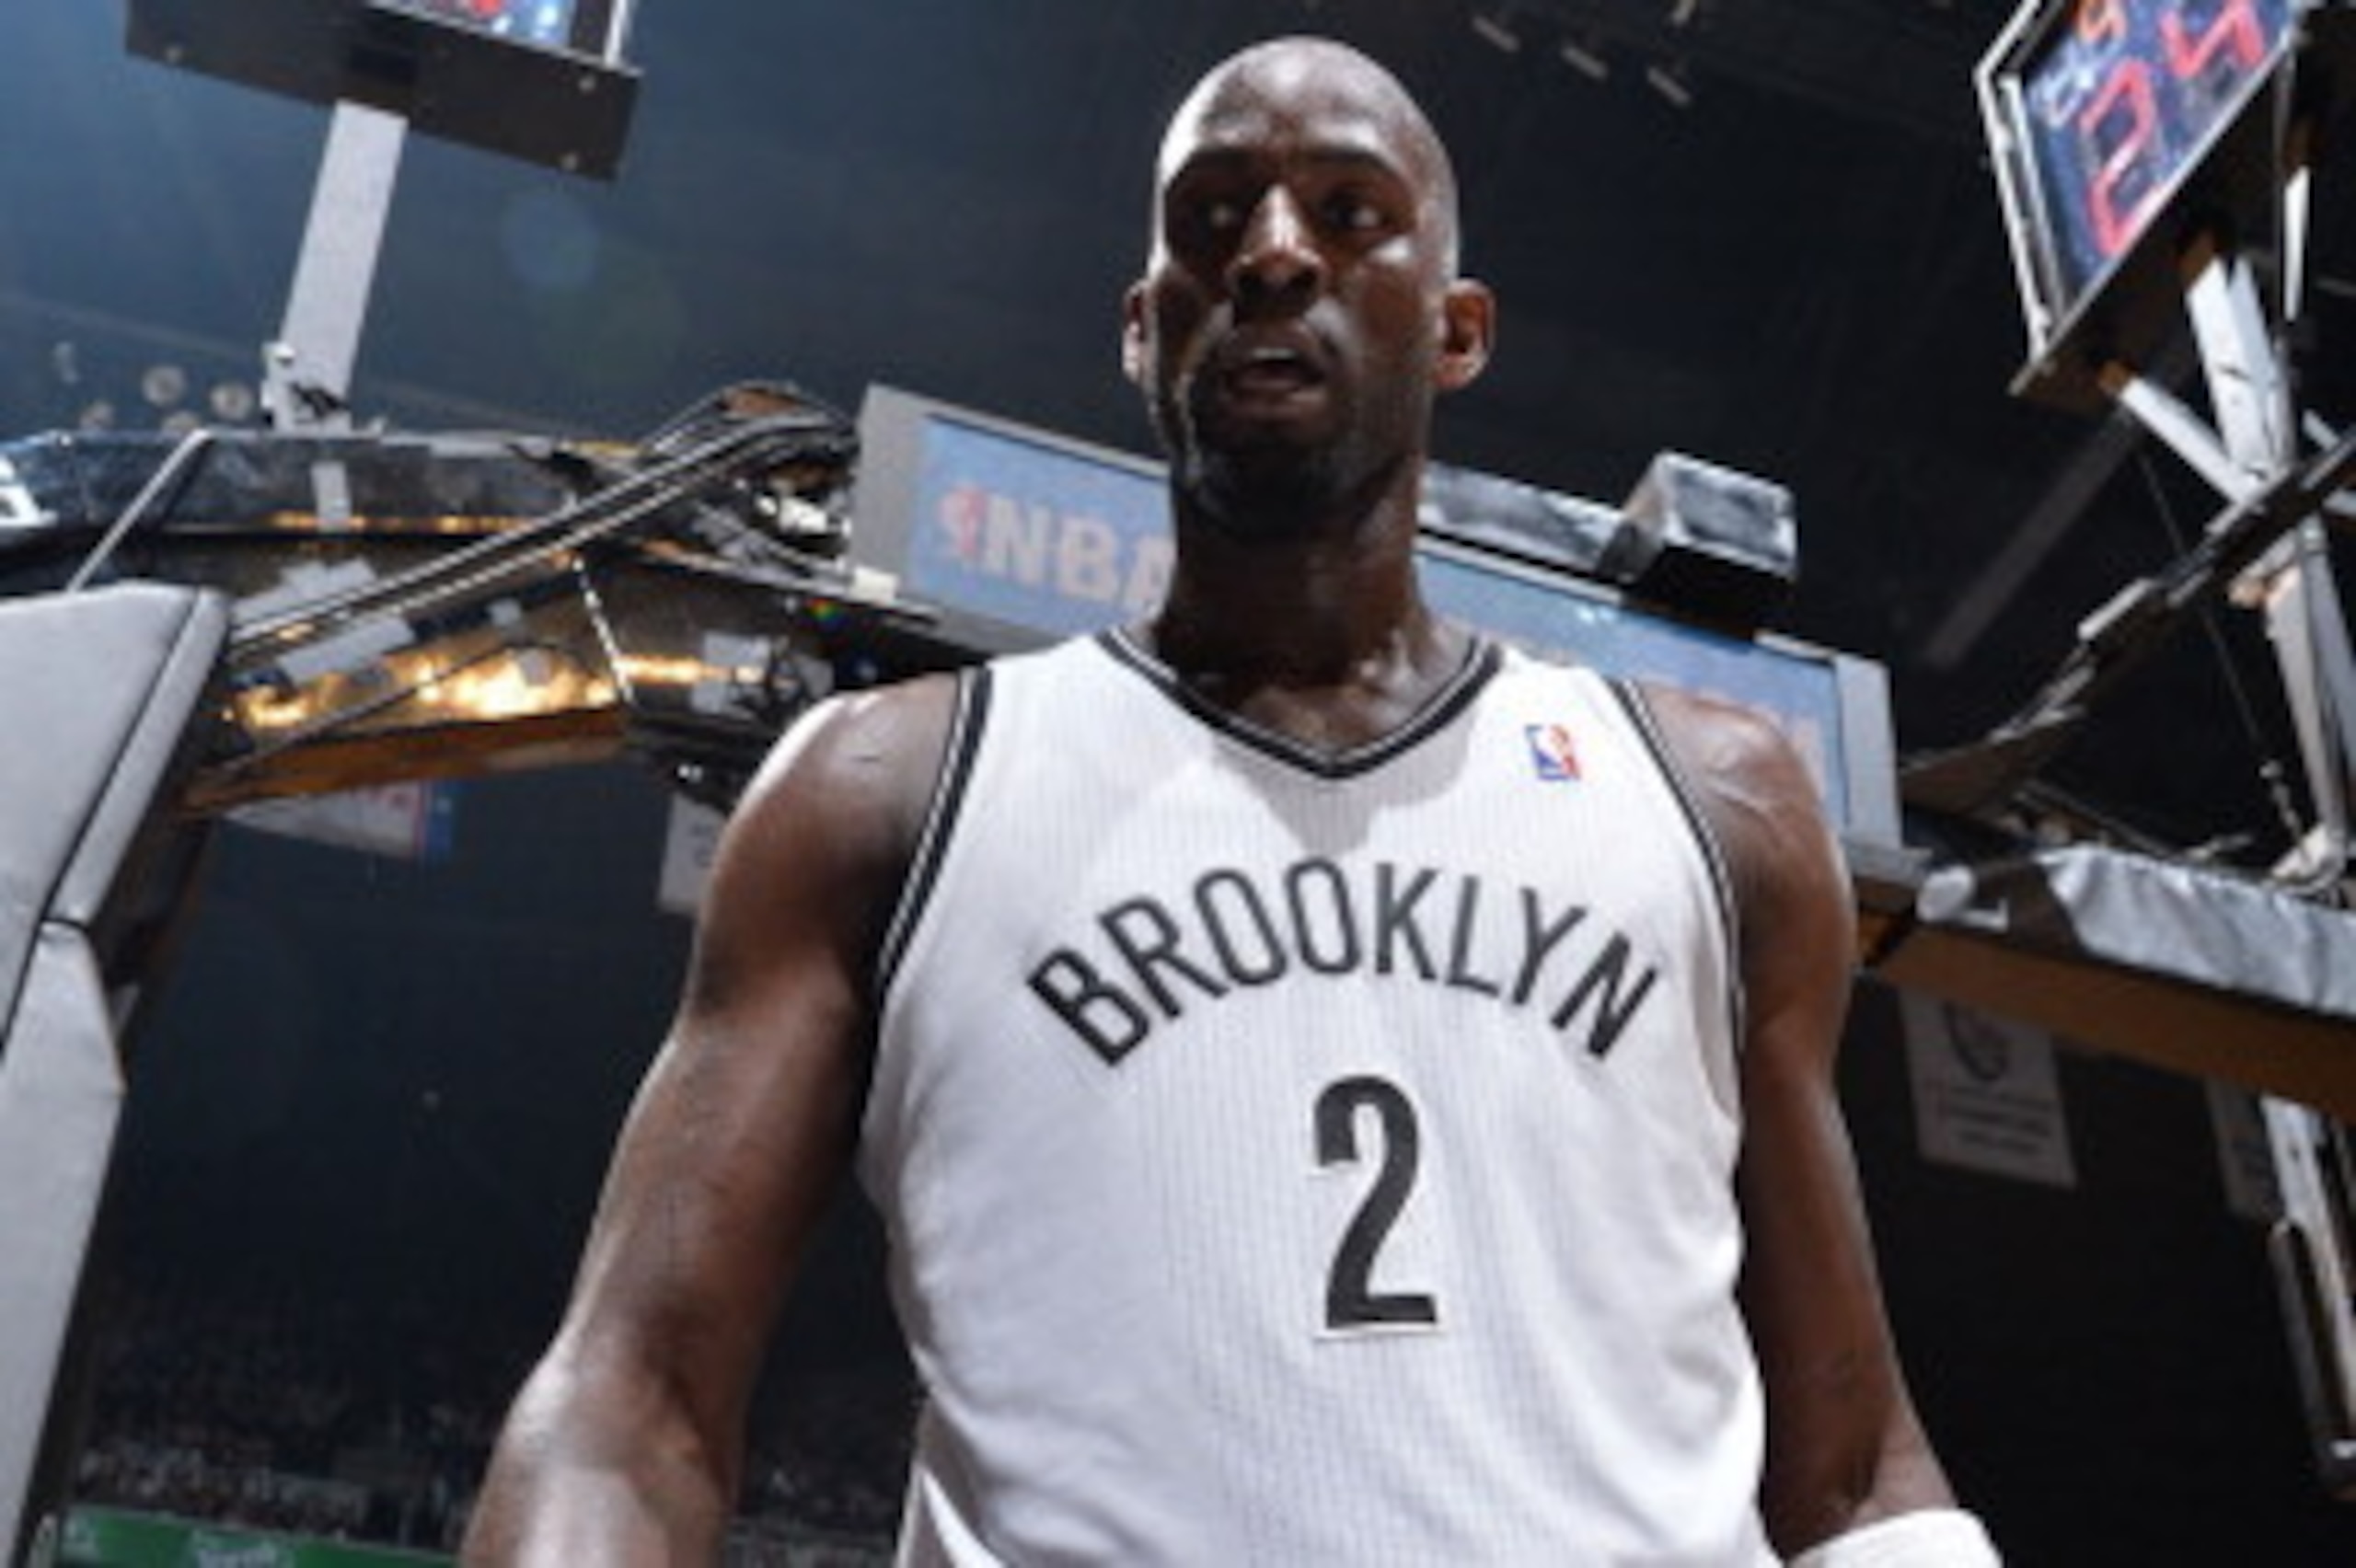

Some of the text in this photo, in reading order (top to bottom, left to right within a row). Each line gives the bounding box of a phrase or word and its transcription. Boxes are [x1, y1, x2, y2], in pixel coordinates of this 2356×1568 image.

[981, 493, 1176, 607] NBA
[1026, 857, 1659, 1066] BROOKLYN
[1312, 1074, 1440, 1331] 2
